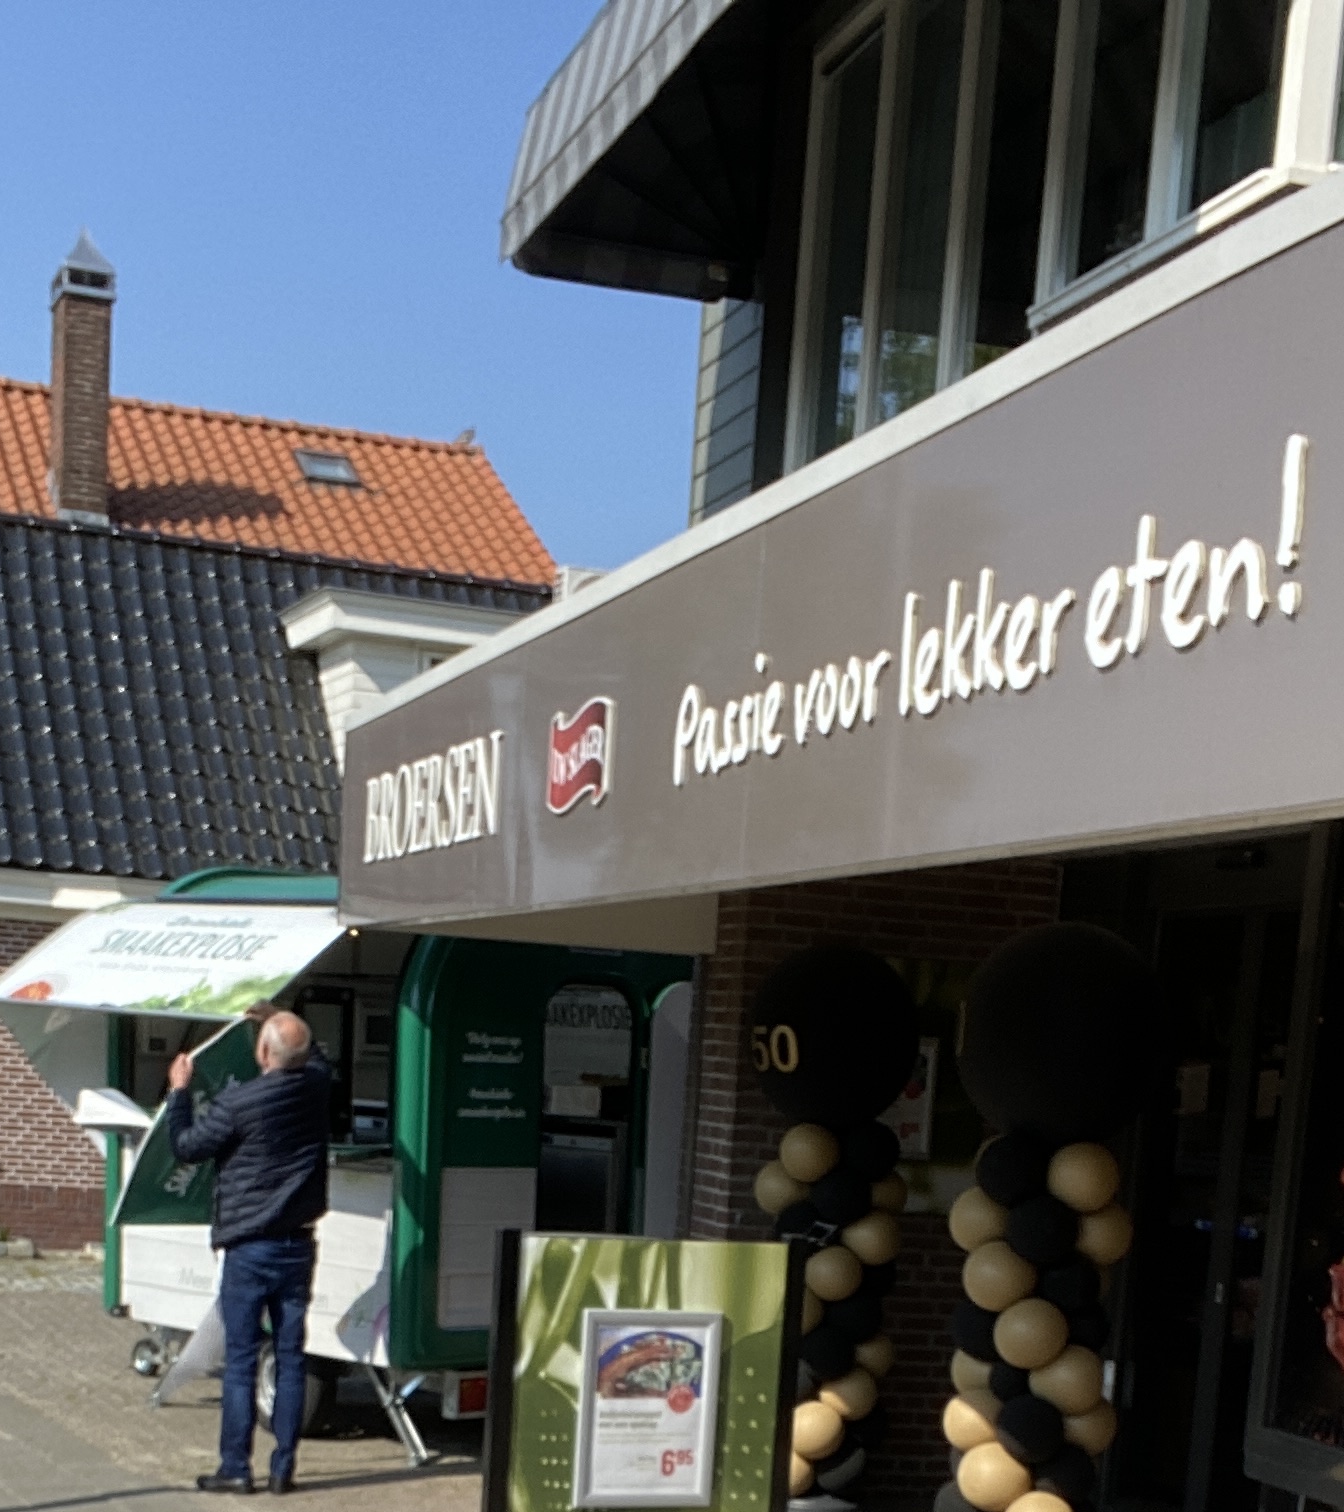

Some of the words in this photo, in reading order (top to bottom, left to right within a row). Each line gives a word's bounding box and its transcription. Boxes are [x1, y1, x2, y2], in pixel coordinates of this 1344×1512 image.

[674, 652, 785, 787] Passie
[794, 649, 890, 743] voor
[900, 567, 1076, 717] lekker
[1086, 433, 1308, 670] eten!
[363, 730, 504, 863] BROERSEN
[752, 1024, 799, 1073] 50
